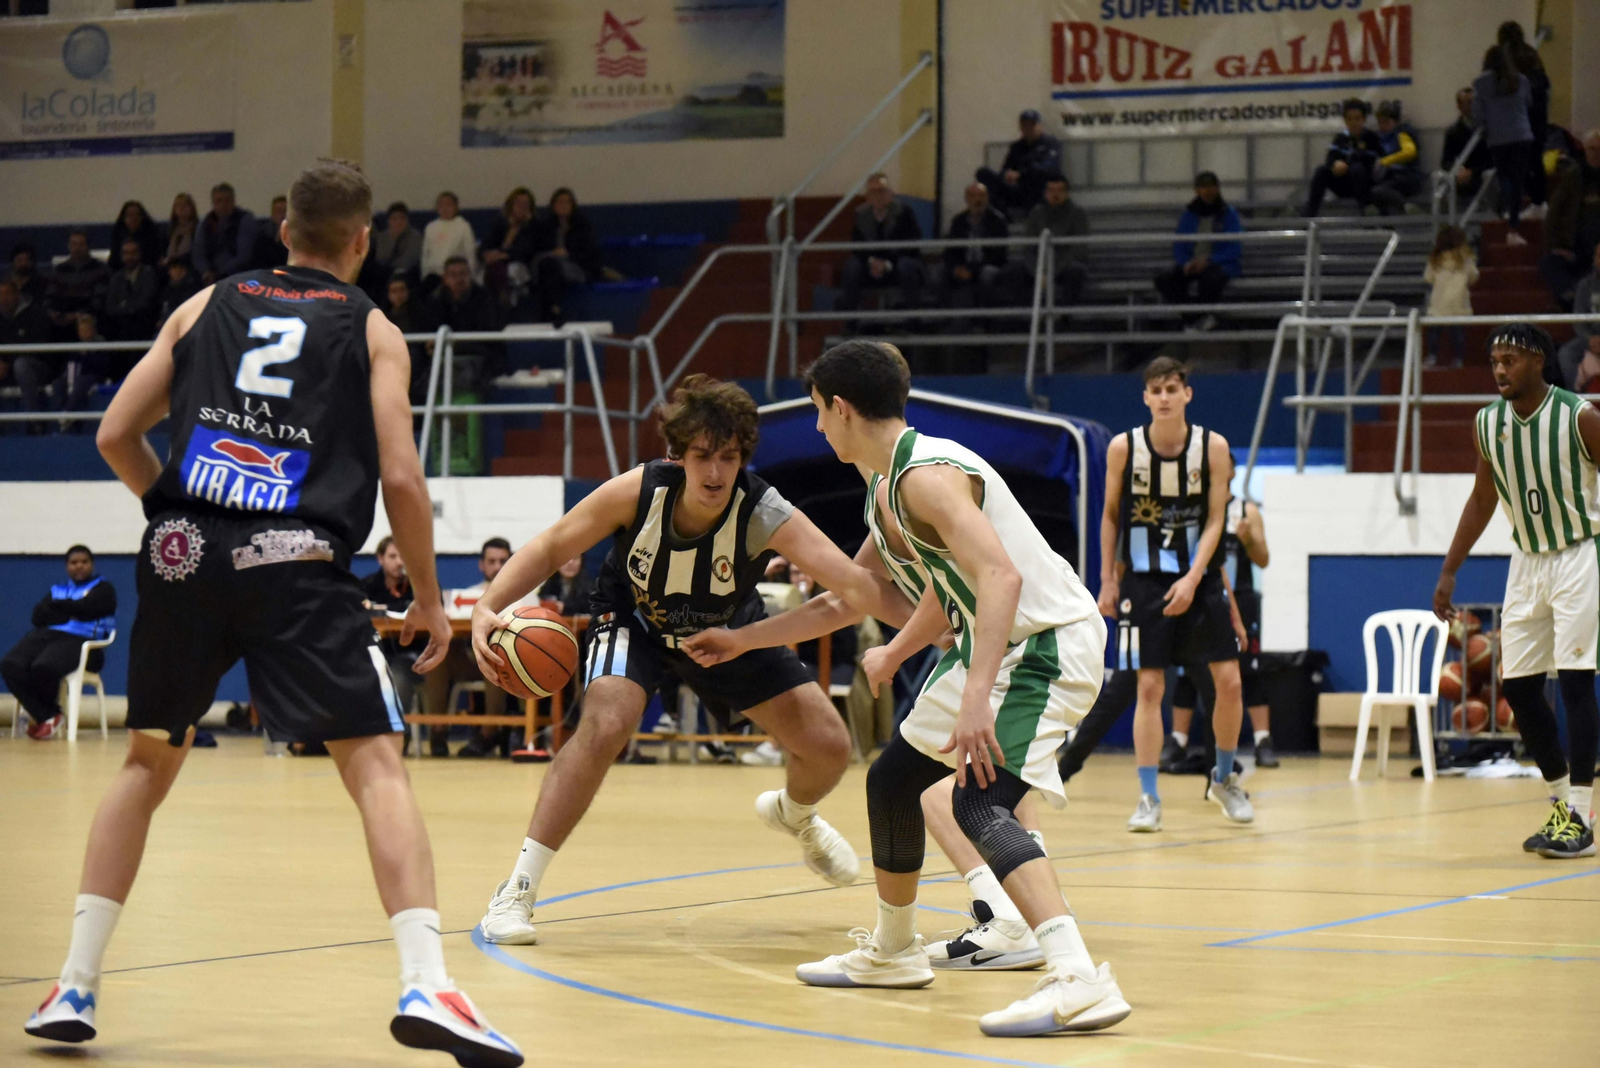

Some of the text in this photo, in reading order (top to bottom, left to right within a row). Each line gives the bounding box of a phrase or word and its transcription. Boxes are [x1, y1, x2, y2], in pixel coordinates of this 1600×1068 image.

[1067, 5, 1398, 84] RUIZ GALAN
[235, 316, 307, 398] 2
[244, 396, 274, 418] LA
[1527, 488, 1544, 515] 0
[1160, 529, 1174, 549] 7
